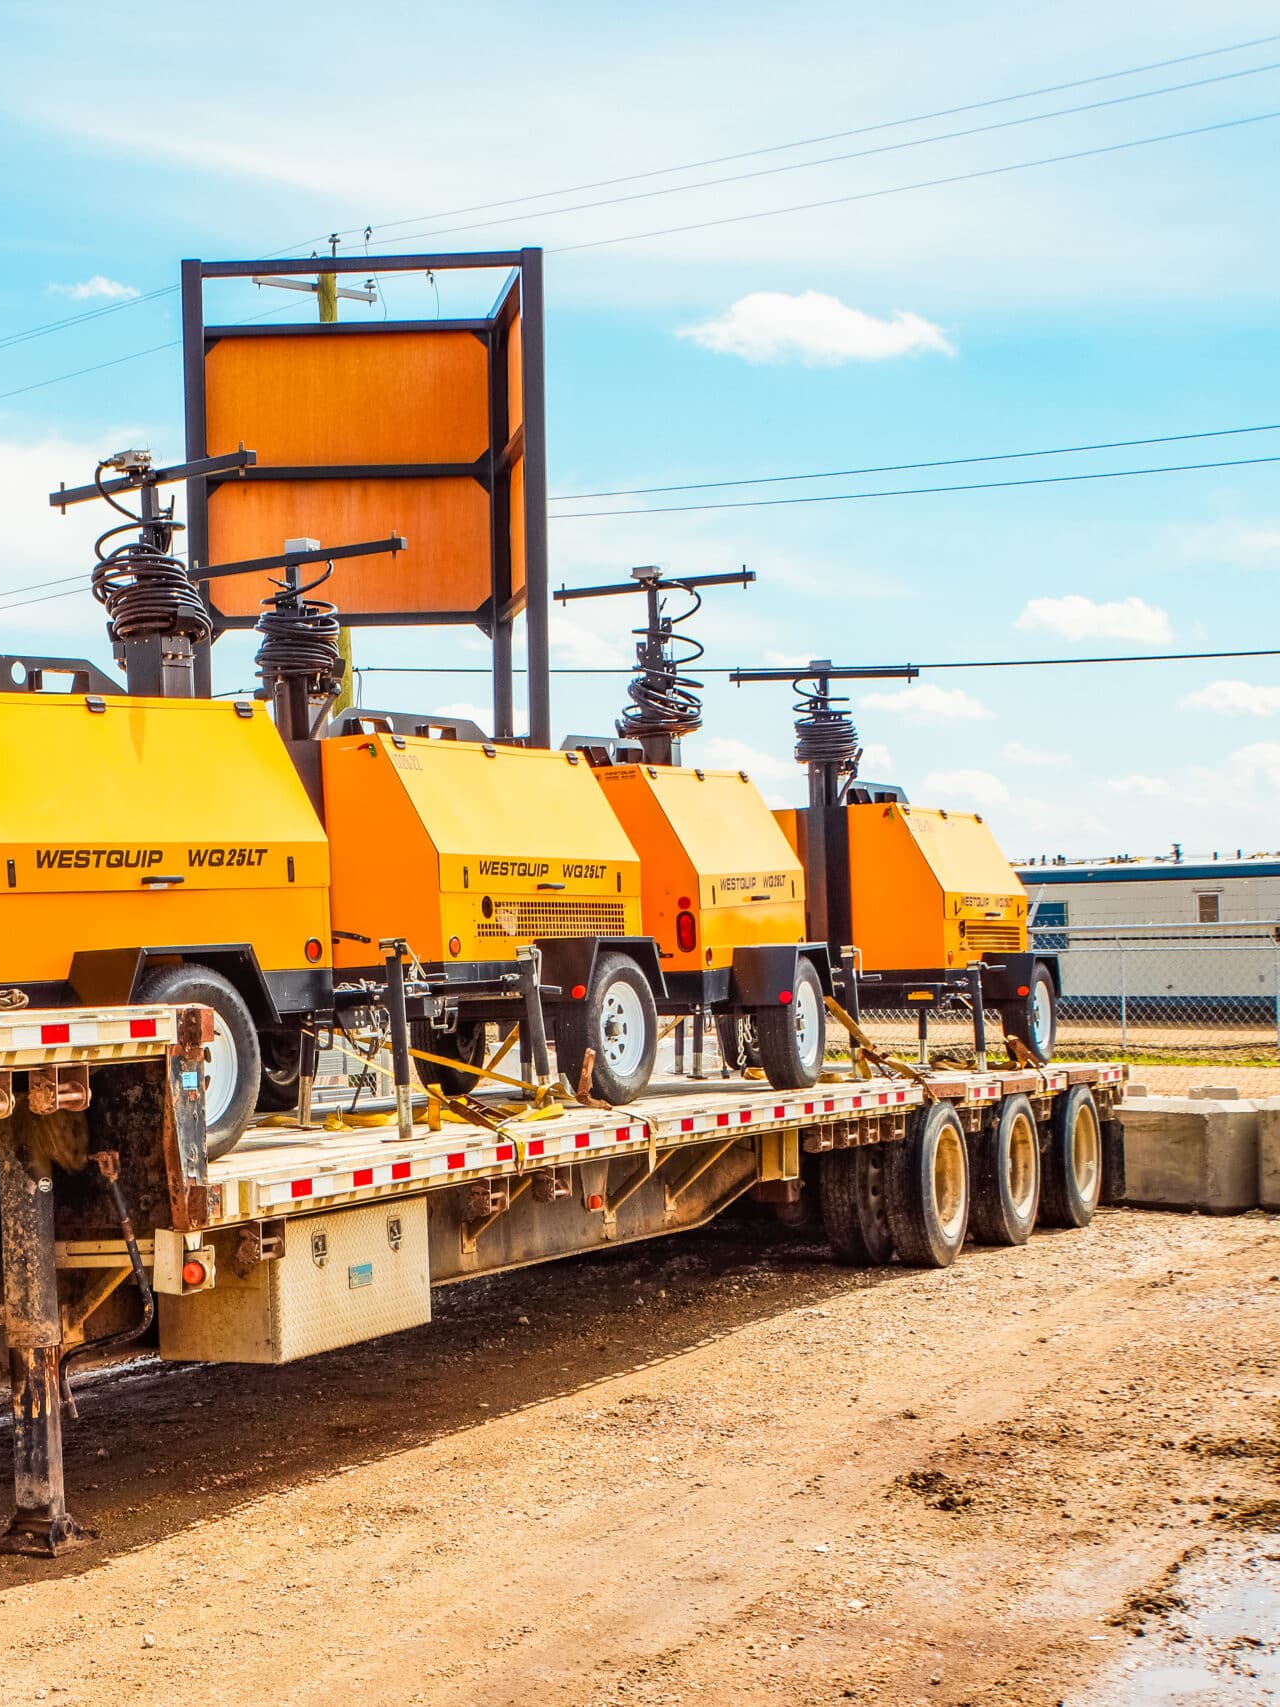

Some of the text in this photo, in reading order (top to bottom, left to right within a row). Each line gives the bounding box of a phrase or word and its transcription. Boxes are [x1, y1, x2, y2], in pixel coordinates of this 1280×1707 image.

[36, 849, 268, 868] WESTQUIP WQ25LT
[479, 860, 607, 879] WESTQUIP WQ25LT
[720, 877, 756, 891] WESTQUIP
